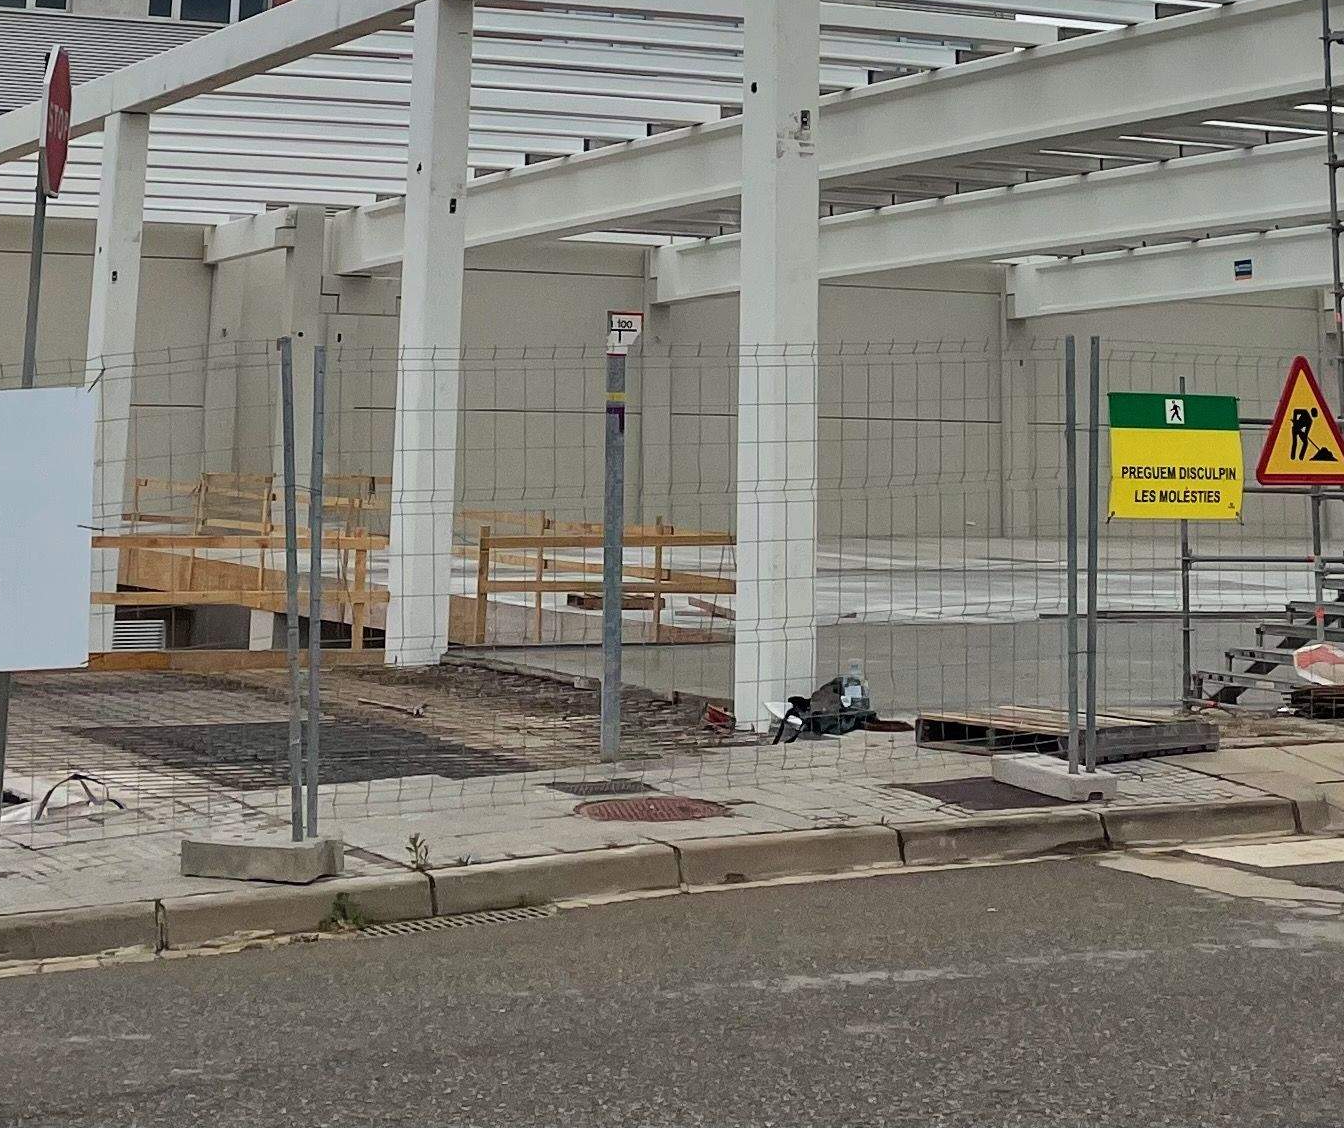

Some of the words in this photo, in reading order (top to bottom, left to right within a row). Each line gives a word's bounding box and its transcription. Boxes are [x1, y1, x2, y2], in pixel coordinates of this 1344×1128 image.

[49, 102, 69, 141] STOP
[1121, 466, 1176, 480] PREGUEM
[1179, 466, 1236, 480] DISCULPIN
[1134, 489, 1156, 503] LES
